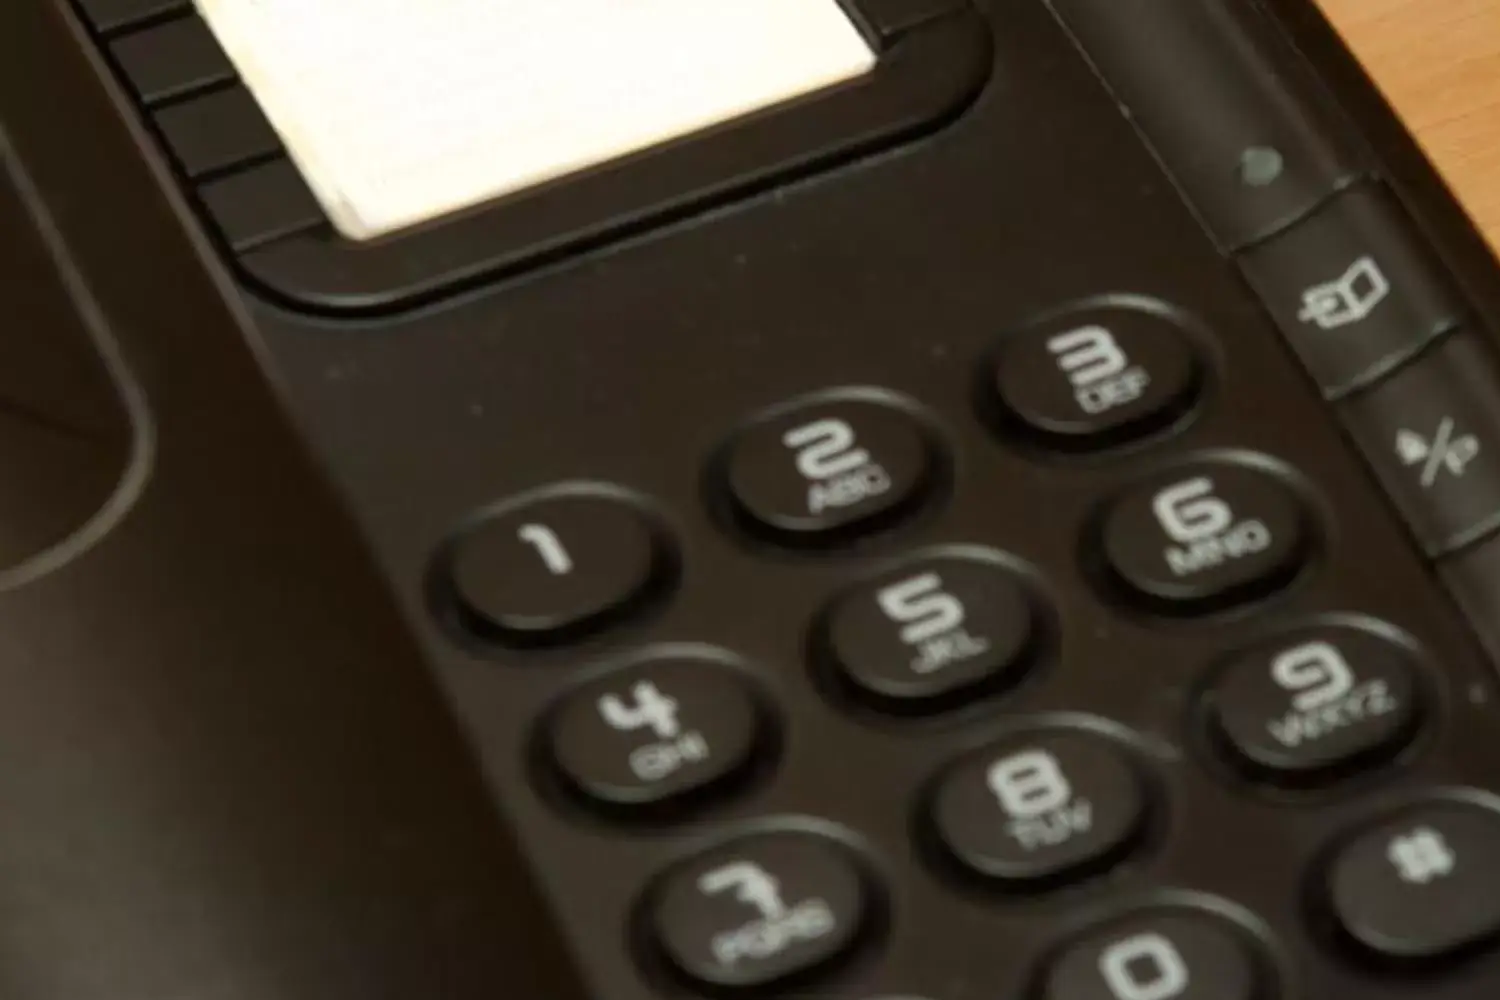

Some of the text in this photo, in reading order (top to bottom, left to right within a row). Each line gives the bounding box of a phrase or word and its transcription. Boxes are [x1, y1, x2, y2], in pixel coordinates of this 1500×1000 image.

[1047, 325, 1128, 385] 3
[783, 418, 870, 479] 2
[1153, 476, 1233, 543] 6
[517, 523, 573, 574] 1
[877, 572, 965, 644] 5
[1270, 641, 1355, 711] 9
[598, 680, 679, 738] 4
[986, 748, 1072, 818] 8
[697, 860, 785, 920] 7
